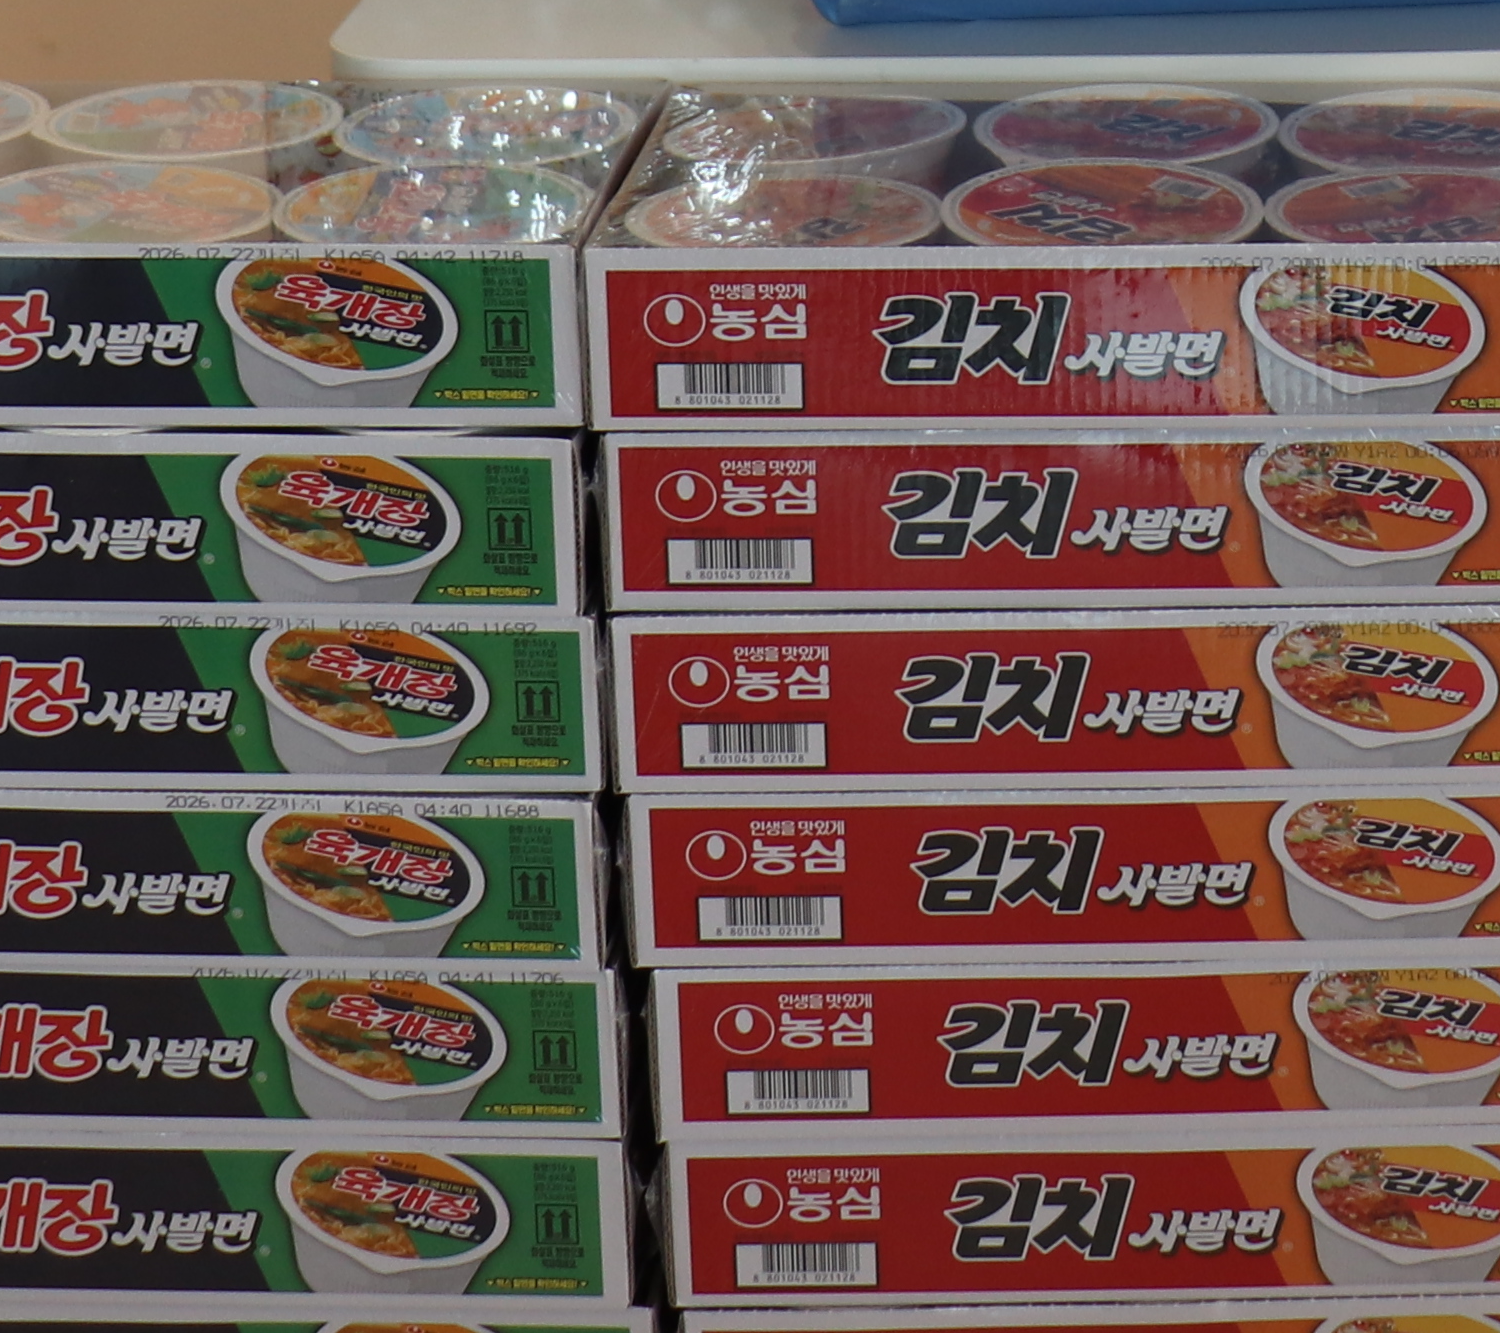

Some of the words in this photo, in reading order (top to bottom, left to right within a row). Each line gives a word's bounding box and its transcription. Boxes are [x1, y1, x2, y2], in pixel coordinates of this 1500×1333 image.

[273, 273, 427, 331] 육개장
[47, 322, 198, 365] 사발면
[720, 478, 816, 515] 농심
[881, 467, 1079, 559] 김치
[1071, 506, 1226, 550] 사발면
[82, 690, 232, 732] 사발면
[750, 820, 794, 835] 인생을
[797, 820, 844, 835] 맛있게
[1352, 818, 1465, 859] 김치
[750, 838, 845, 874] 농심
[909, 826, 1105, 914] 김치
[1097, 862, 1251, 905] 사발면
[106, 1037, 253, 1078] 사발면
[787, 1186, 880, 1221] 농심
[943, 1173, 1136, 1260] 김치
[1128, 1208, 1280, 1251] 사발면
